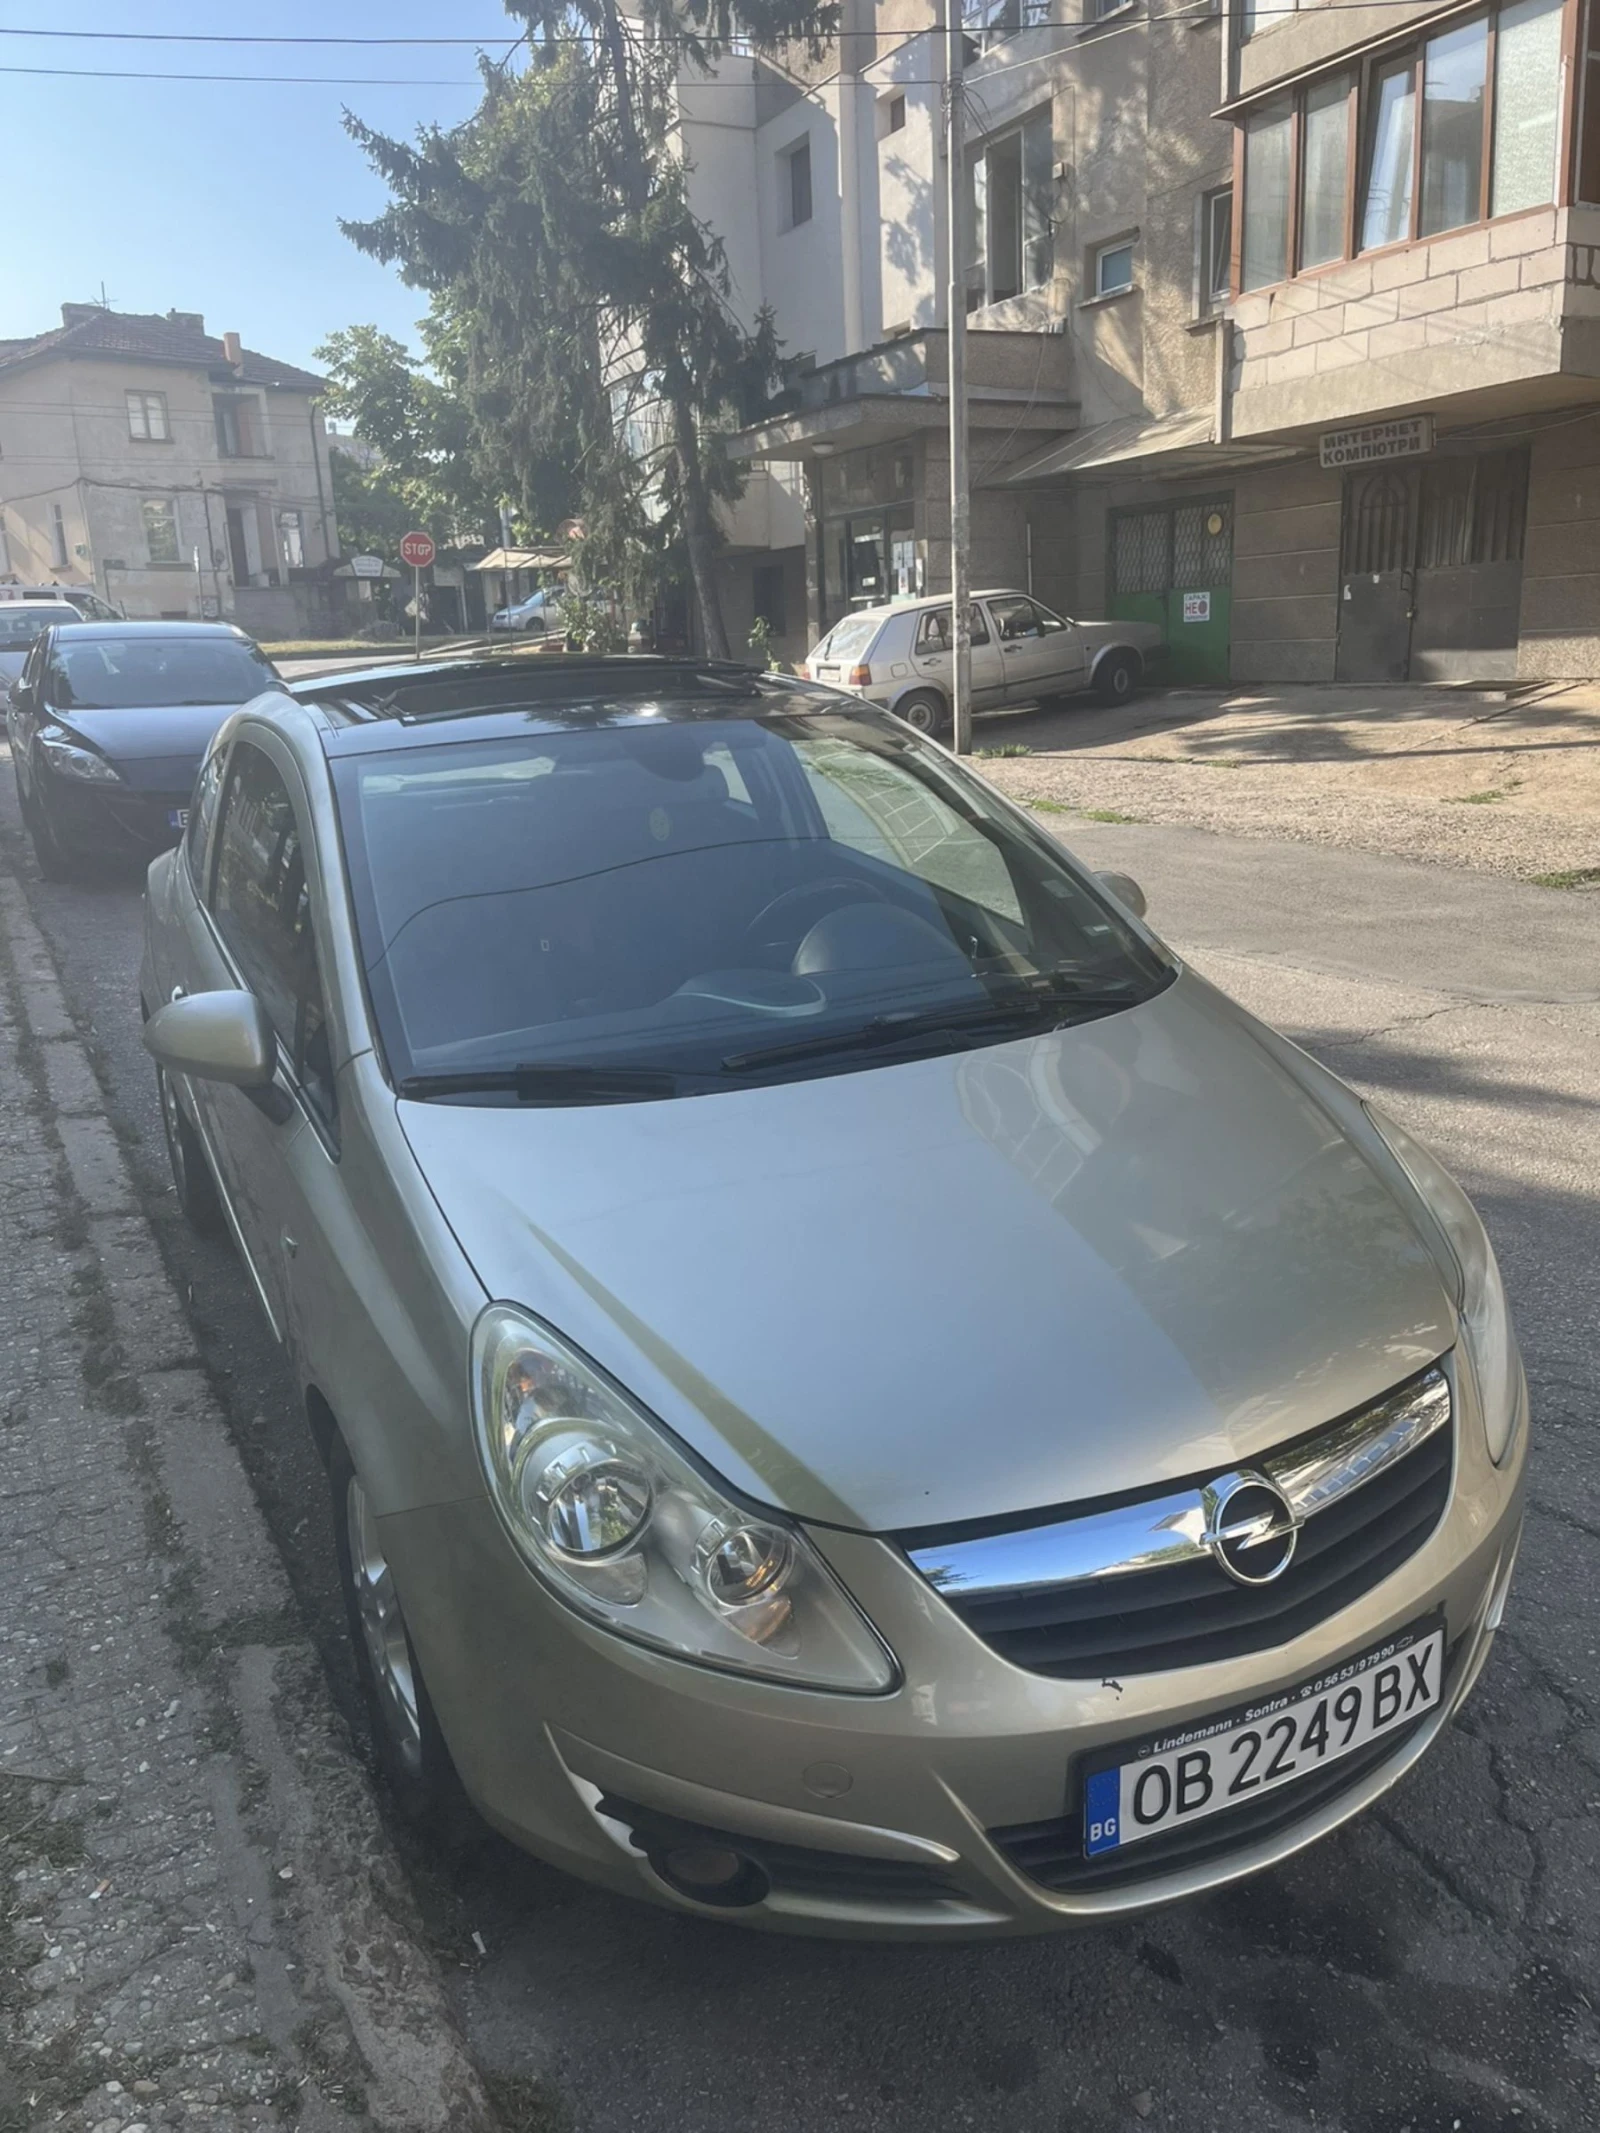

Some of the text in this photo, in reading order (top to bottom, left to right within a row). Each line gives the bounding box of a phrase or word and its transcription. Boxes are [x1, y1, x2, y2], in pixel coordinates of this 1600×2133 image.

[1324, 421, 1422, 449] ИНТЕРНЕТ
[1323, 437, 1420, 465] КОМПЮТРИ
[404, 542, 432, 556] STOP
[1185, 602, 1198, 614] НЕ
[1133, 1643, 1434, 1825] OB 2249 BX
[1153, 1719, 1232, 1753] Lindemann
[1245, 1697, 1288, 1721] Sontra
[1090, 1818, 1116, 1842] BG
